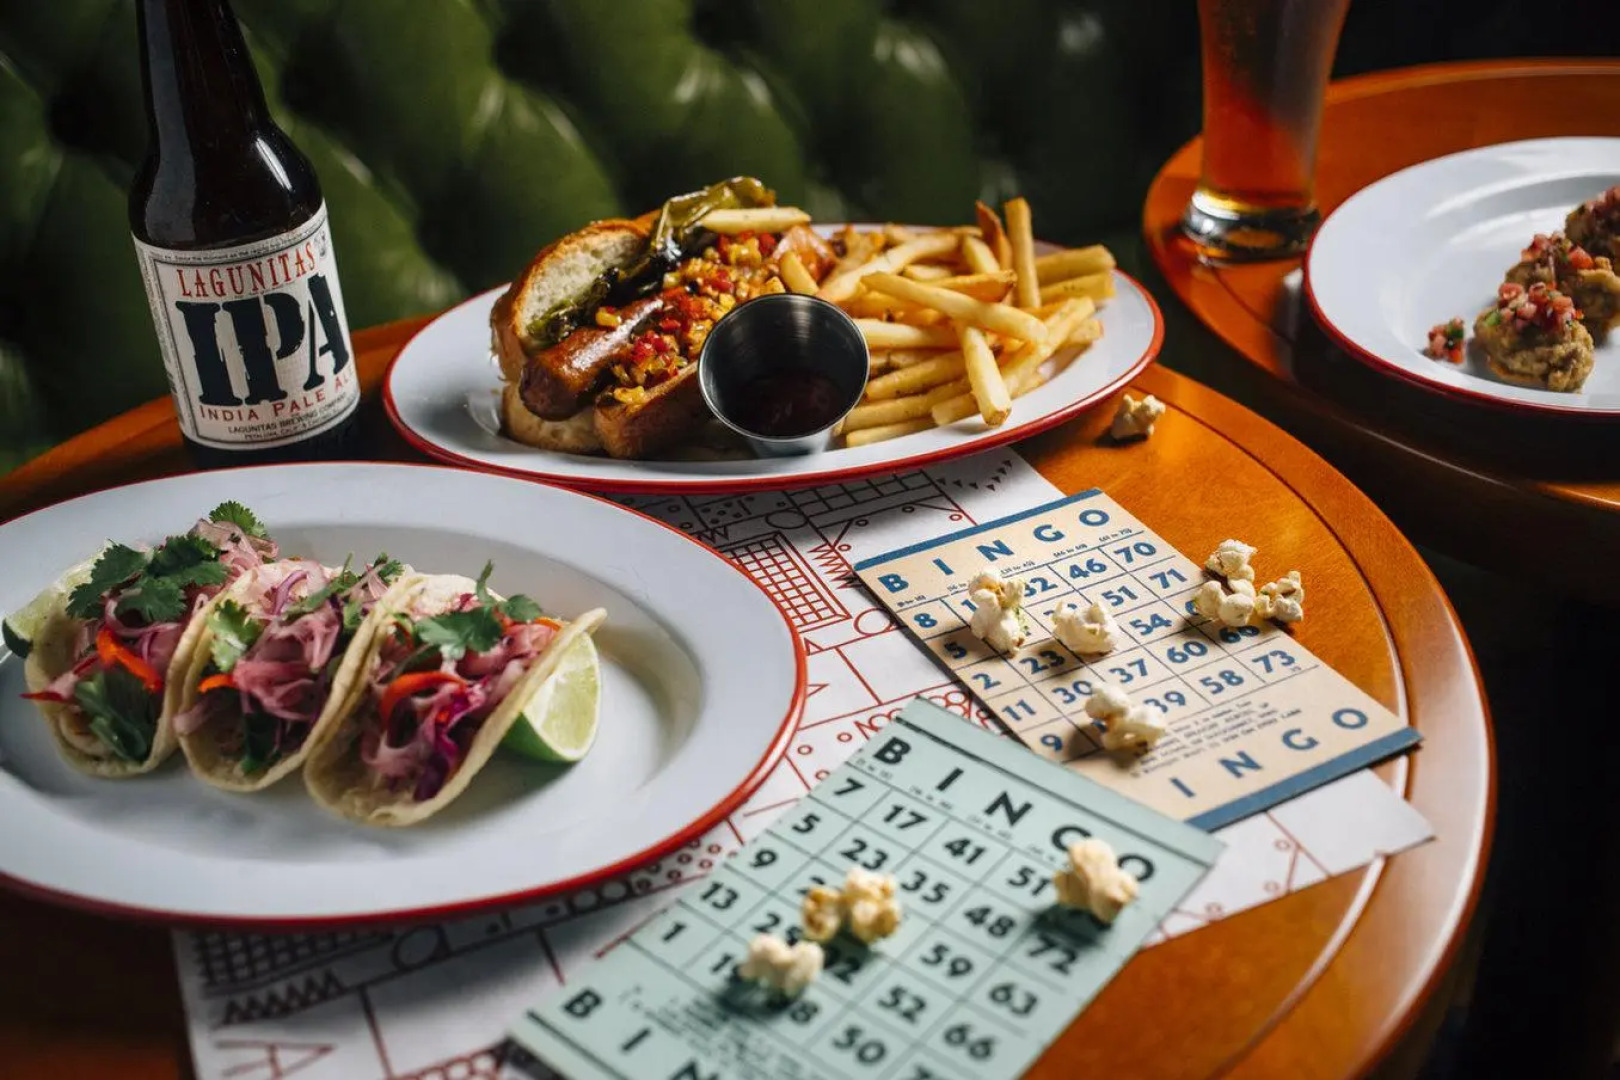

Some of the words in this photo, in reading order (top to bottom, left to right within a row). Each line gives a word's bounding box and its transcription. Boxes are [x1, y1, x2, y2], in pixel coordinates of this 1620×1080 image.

[177, 241, 315, 298] LAGUNITAS
[175, 272, 349, 407] IPA
[200, 405, 259, 422] INDIA
[272, 389, 325, 417] PALE
[228, 424, 277, 433] LAGUNITAS
[280, 410, 318, 427] BREWING
[878, 572, 909, 593] B
[976, 540, 1014, 562] N
[1034, 524, 1065, 542] G
[913, 613, 937, 628] 8
[1070, 558, 1107, 579] 46
[1113, 542, 1156, 564] 70
[943, 642, 967, 659] 5
[1102, 585, 1138, 607] 51
[1148, 568, 1188, 589] 71
[972, 673, 1001, 690] 2
[1019, 651, 1065, 674] 23
[1130, 613, 1172, 636] 54
[1002, 699, 1037, 721] 11
[1052, 680, 1094, 704] 30
[1109, 658, 1148, 683] 37
[1167, 640, 1208, 664] 60
[1040, 734, 1063, 752] 9
[1143, 690, 1187, 714] 39
[1199, 669, 1244, 695] 58
[1252, 650, 1295, 673] 73
[873, 737, 912, 766] B
[985, 791, 1033, 826] N
[833, 778, 866, 797] 7
[884, 805, 927, 830] 17
[944, 837, 986, 866] 41
[1008, 865, 1051, 897] 51
[749, 847, 779, 868] 9
[920, 944, 973, 978] 59
[988, 982, 1038, 1016] 63
[792, 813, 821, 834] 5
[840, 839, 889, 871] 23
[901, 871, 951, 903] 35
[964, 904, 1016, 938] 48
[1026, 934, 1077, 975] 72
[662, 921, 686, 943] 1
[833, 1026, 886, 1065] 50
[702, 882, 739, 911] 13
[878, 987, 927, 1023] 52
[944, 1024, 996, 1060] 66
